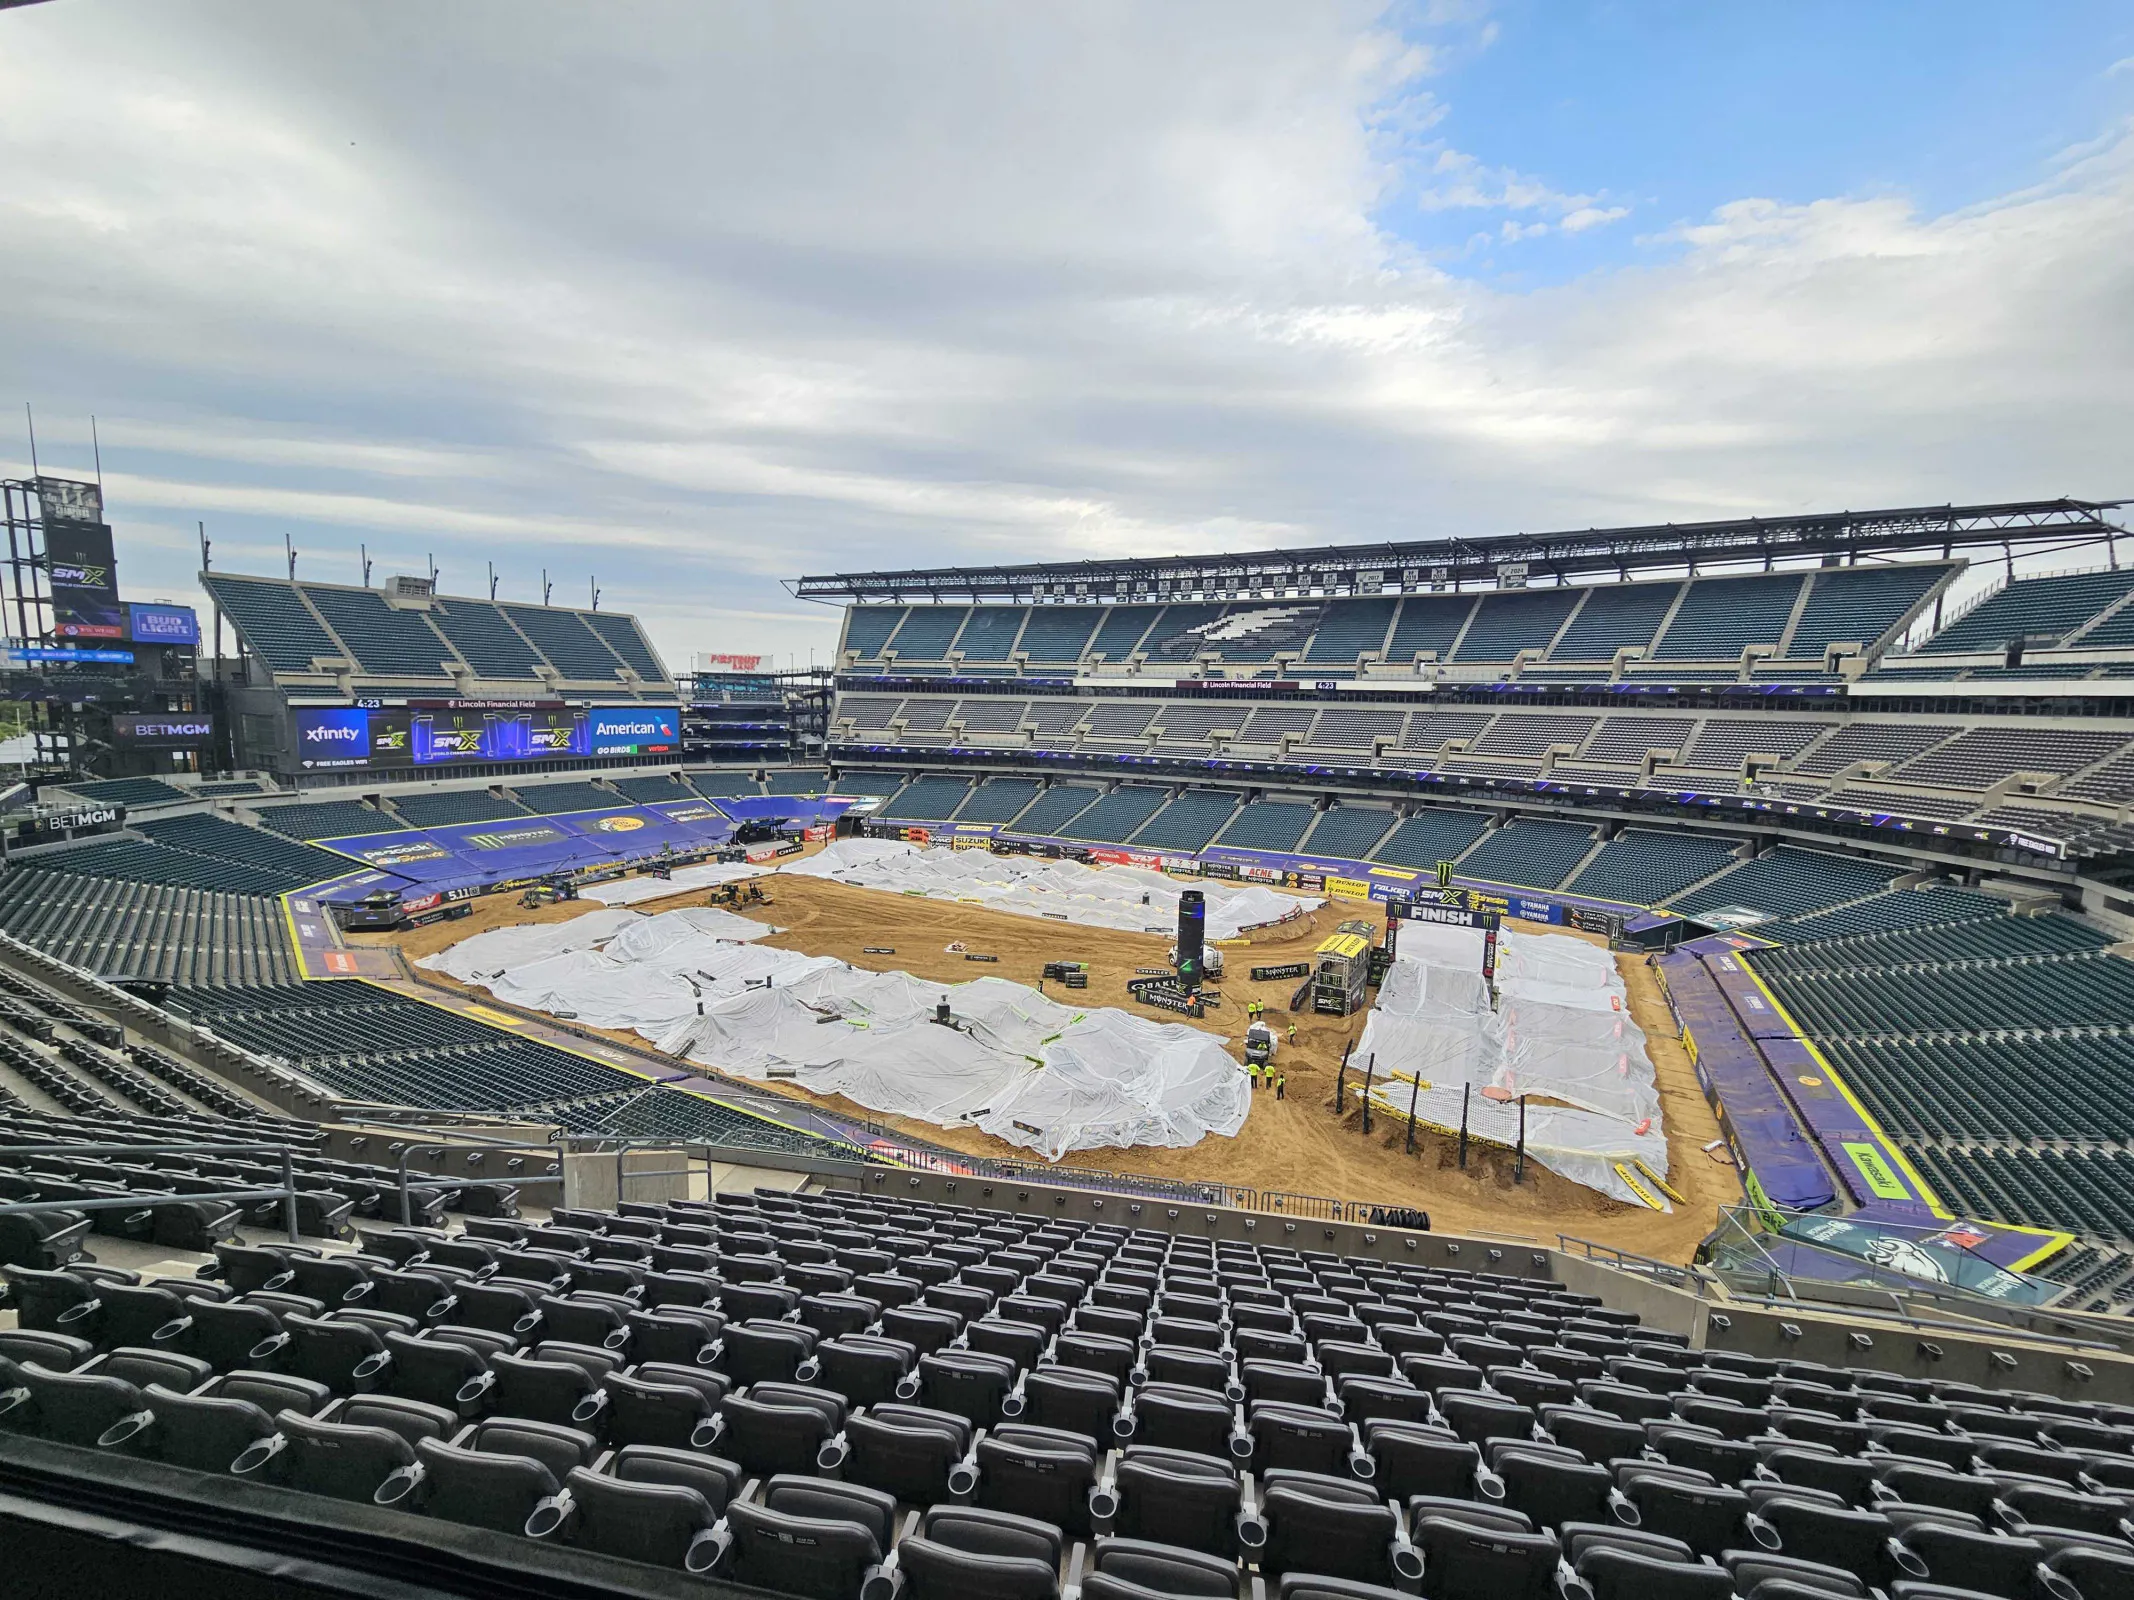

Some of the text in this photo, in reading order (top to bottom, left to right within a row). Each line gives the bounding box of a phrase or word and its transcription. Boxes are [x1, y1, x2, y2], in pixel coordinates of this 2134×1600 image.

[52, 567, 106, 586] SMX
[147, 615, 182, 625] BUD
[141, 623, 188, 634] LIGHT
[357, 700, 380, 708] 4:23
[135, 724, 210, 736] BETMGM
[306, 725, 360, 742] xfinity
[596, 721, 655, 736] American
[376, 733, 404, 747] SMX
[432, 733, 480, 750] SMX
[531, 730, 571, 747] SMX
[597, 746, 631, 755] GO BIRDS
[50, 809, 116, 830] BETMGM
[499, 829, 554, 840] MONSTER
[364, 844, 428, 860] peacock
[1249, 868, 1273, 878] ACME
[447, 888, 470, 901] 5.11
[1334, 888, 1366, 897] DUNLOP
[1373, 884, 1410, 896] FALKEN
[1420, 890, 1463, 906] SMX
[1527, 902, 1550, 911] YAMAHA
[1411, 905, 1473, 926] FINISH
[1526, 911, 1549, 920] YAMAHA
[1266, 967, 1299, 976] MONSTER
[1149, 993, 1188, 1010] MONSTER
[1318, 998, 1341, 1008] SMX
[1402, 1116, 1437, 1131] DNLOP
[1855, 1151, 1896, 1189] Kawasaki
